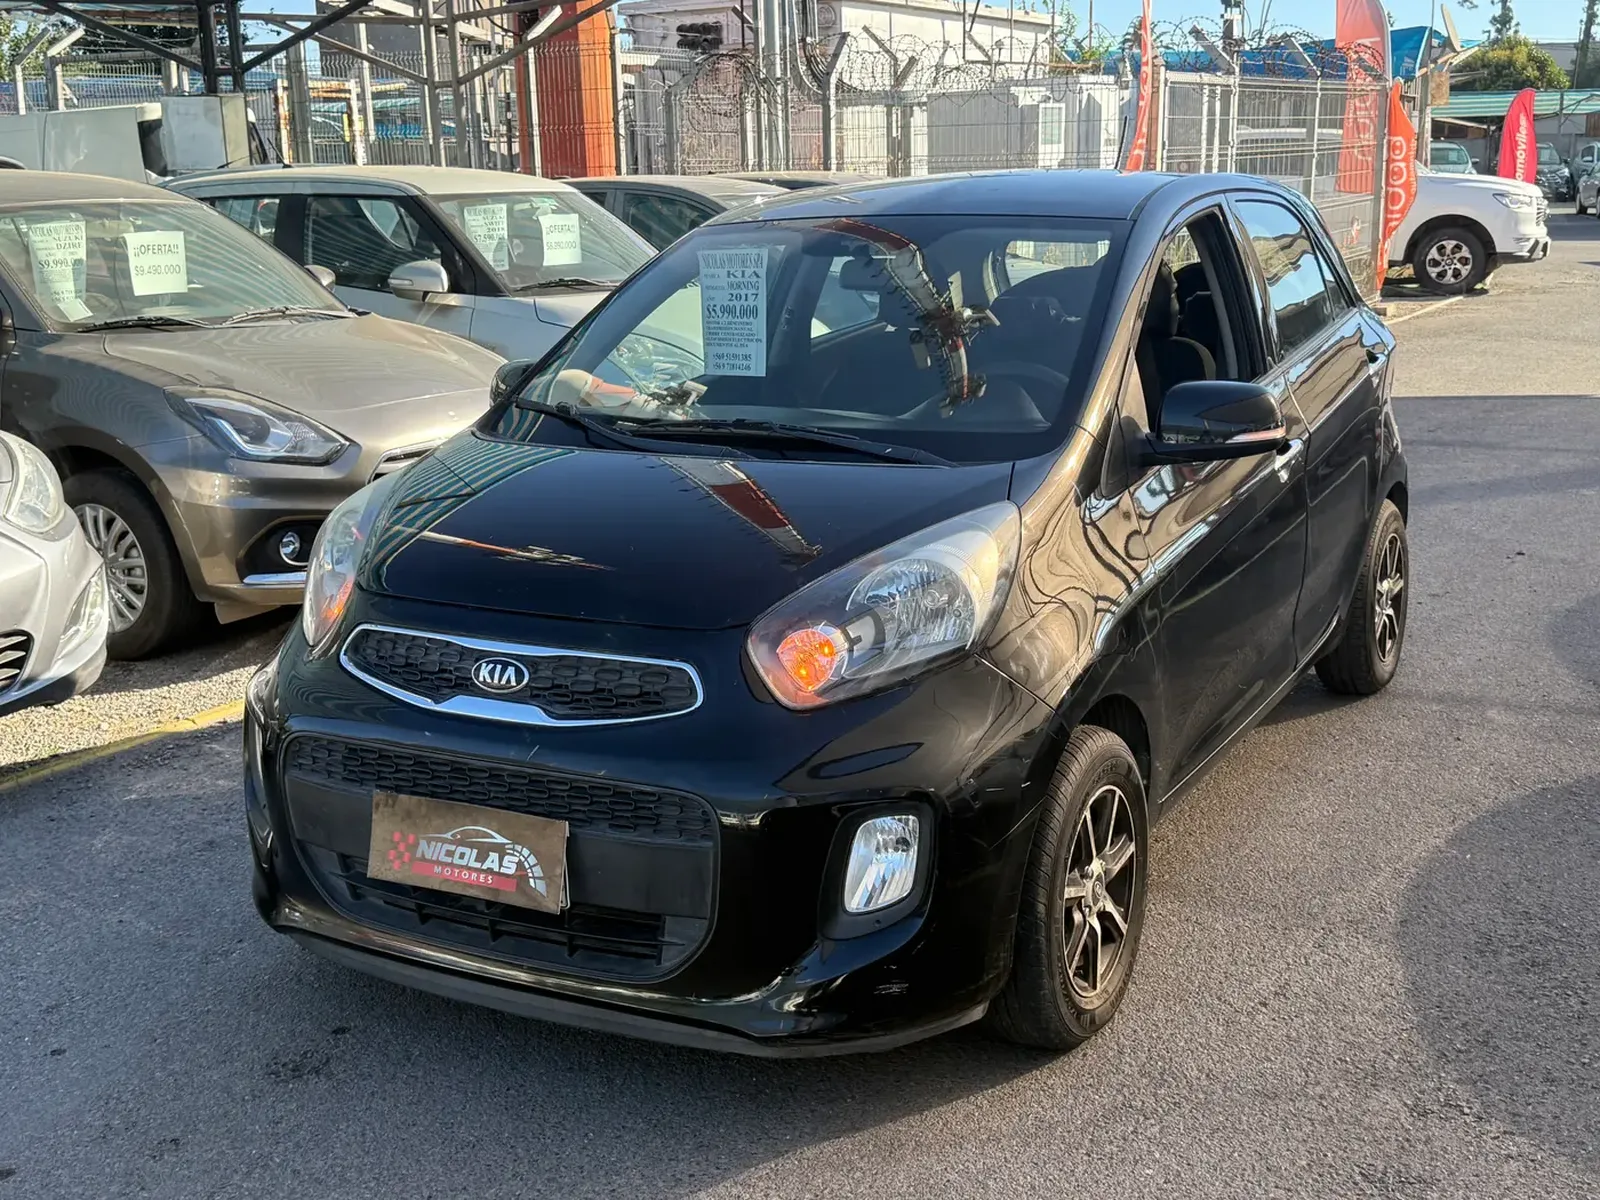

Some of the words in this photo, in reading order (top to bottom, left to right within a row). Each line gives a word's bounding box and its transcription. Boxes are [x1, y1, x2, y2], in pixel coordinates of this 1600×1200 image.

[56, 242, 82, 250] DZIRE
[133, 244, 179, 257] ¡¡OFERTA!!
[727, 270, 762, 279] KIA
[727, 280, 759, 291] MORNING
[728, 293, 759, 302] 2017
[706, 304, 759, 319] $5.990.000
[478, 663, 517, 686] KIA
[415, 840, 520, 875] NICOLAS
[434, 865, 494, 884] MOTORES
